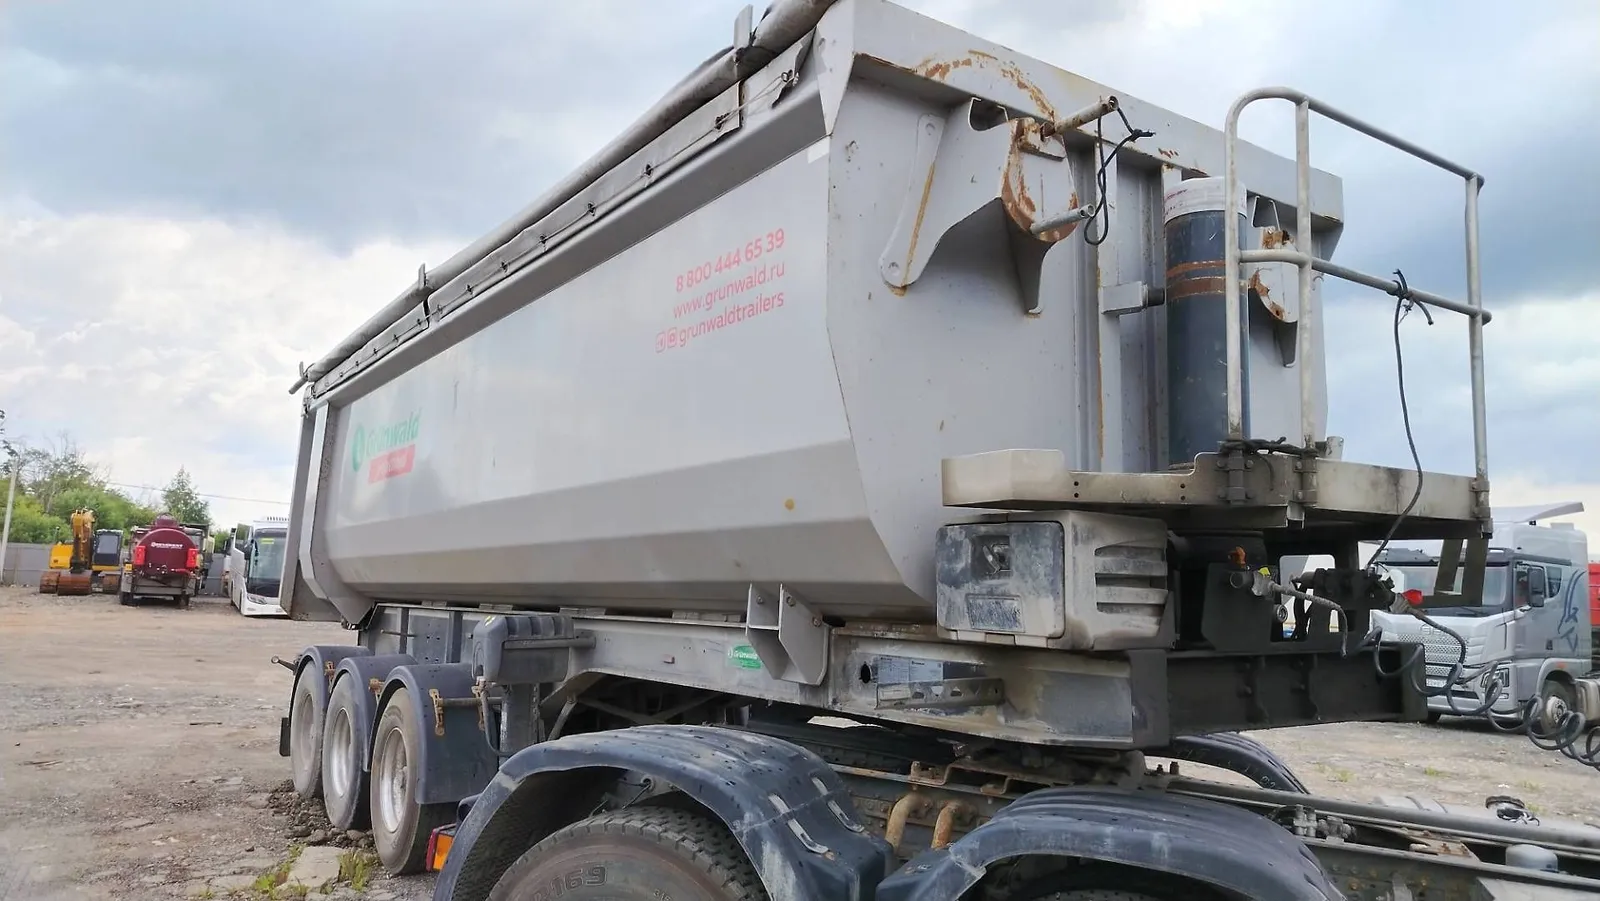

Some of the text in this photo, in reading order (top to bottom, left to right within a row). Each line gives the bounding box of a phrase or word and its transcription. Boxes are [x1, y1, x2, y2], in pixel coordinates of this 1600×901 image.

[675, 227, 785, 293] 8 800 444 65 39
[673, 262, 785, 319] www.grunwald.ru
[679, 292, 784, 348] grunwaldtrailers
